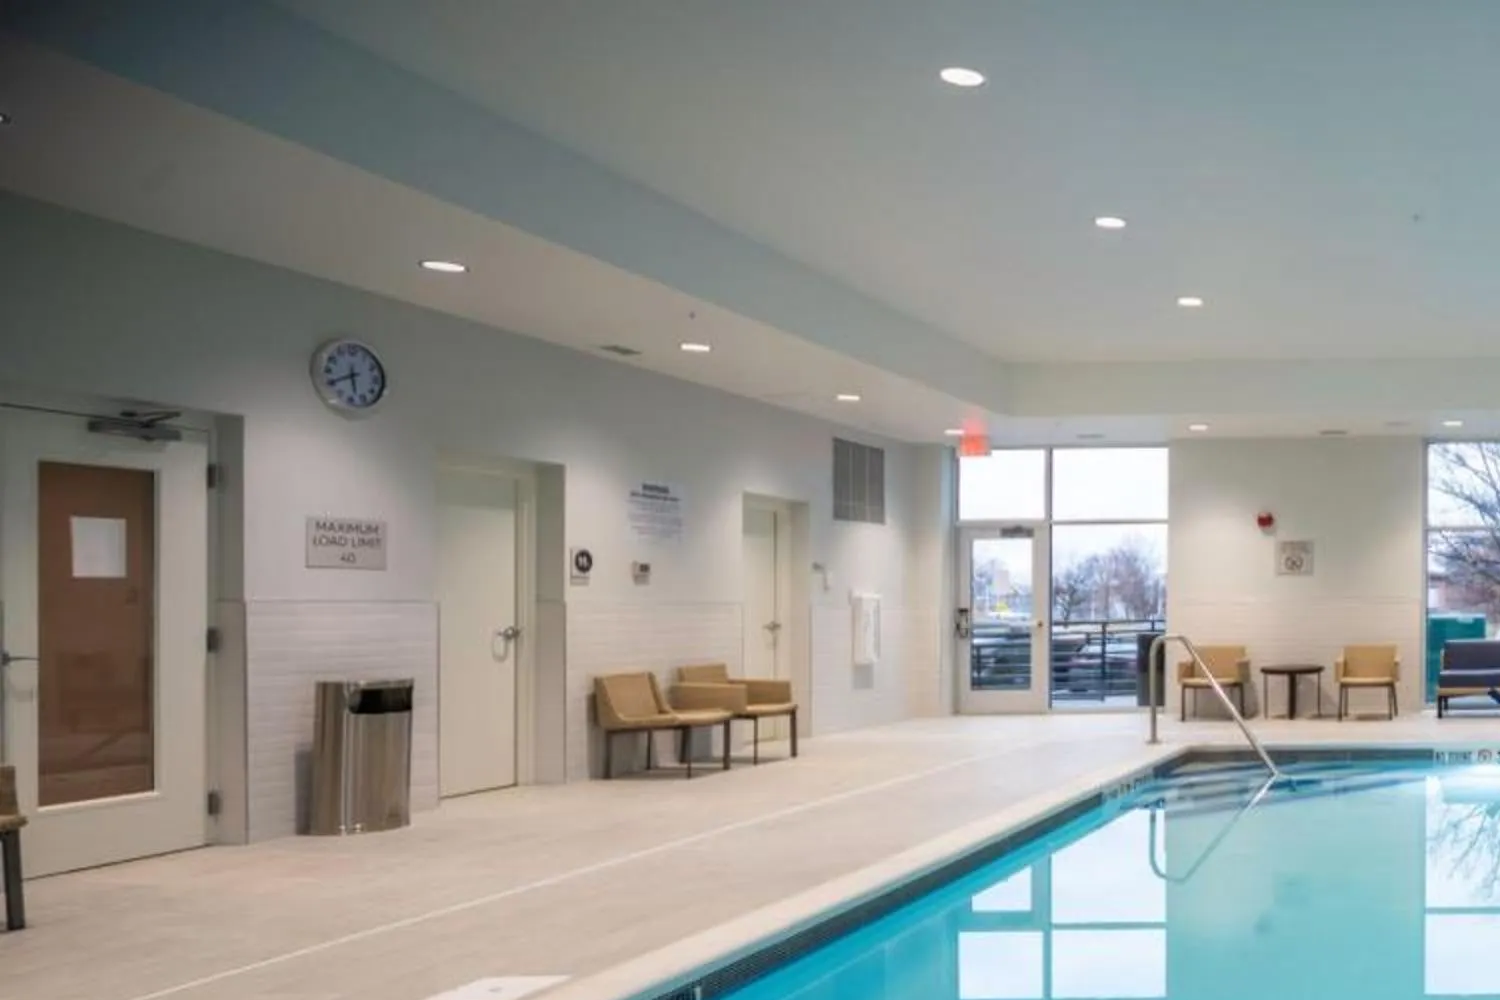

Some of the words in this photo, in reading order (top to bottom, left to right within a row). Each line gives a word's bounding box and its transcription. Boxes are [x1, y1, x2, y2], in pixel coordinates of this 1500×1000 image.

[315, 520, 380, 535] MAXIMUM
[312, 534, 347, 548] LOAD
[350, 536, 382, 549] LIMIT
